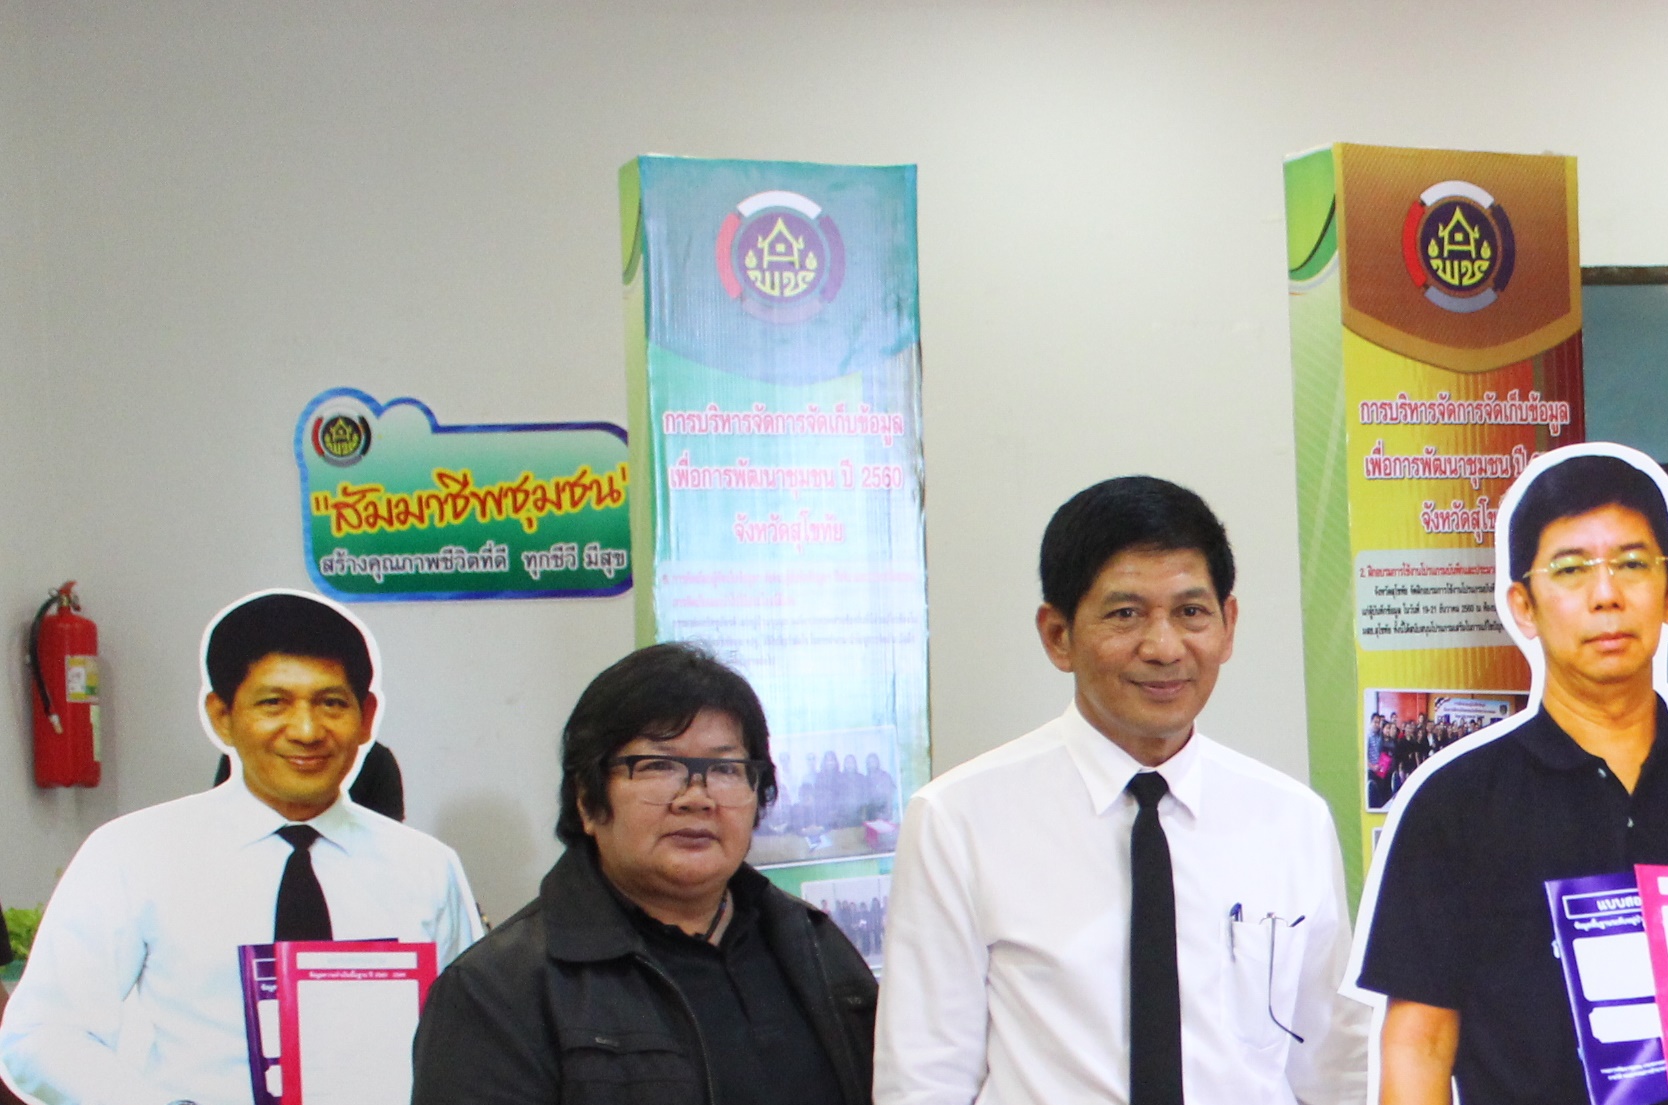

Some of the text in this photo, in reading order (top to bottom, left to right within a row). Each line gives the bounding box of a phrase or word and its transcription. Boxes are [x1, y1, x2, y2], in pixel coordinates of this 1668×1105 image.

[663, 403, 904, 447] การบริหารจัดการจัดเก็บข้อมูล
[1359, 388, 1570, 436] การบริหารจัดการจัดเก็บข้อมูล
[669, 450, 904, 499] เพื่อการพัฒนาชุมชน ปี 2560
[1364, 440, 1510, 489] เพื่อการพัฒนาชุมชน
[733, 509, 846, 553] จังหวัดสุโขทัย
[320, 542, 627, 583] สร้างคุณภาพชีวิตที่ดี ทุกชีวี มีสุข
